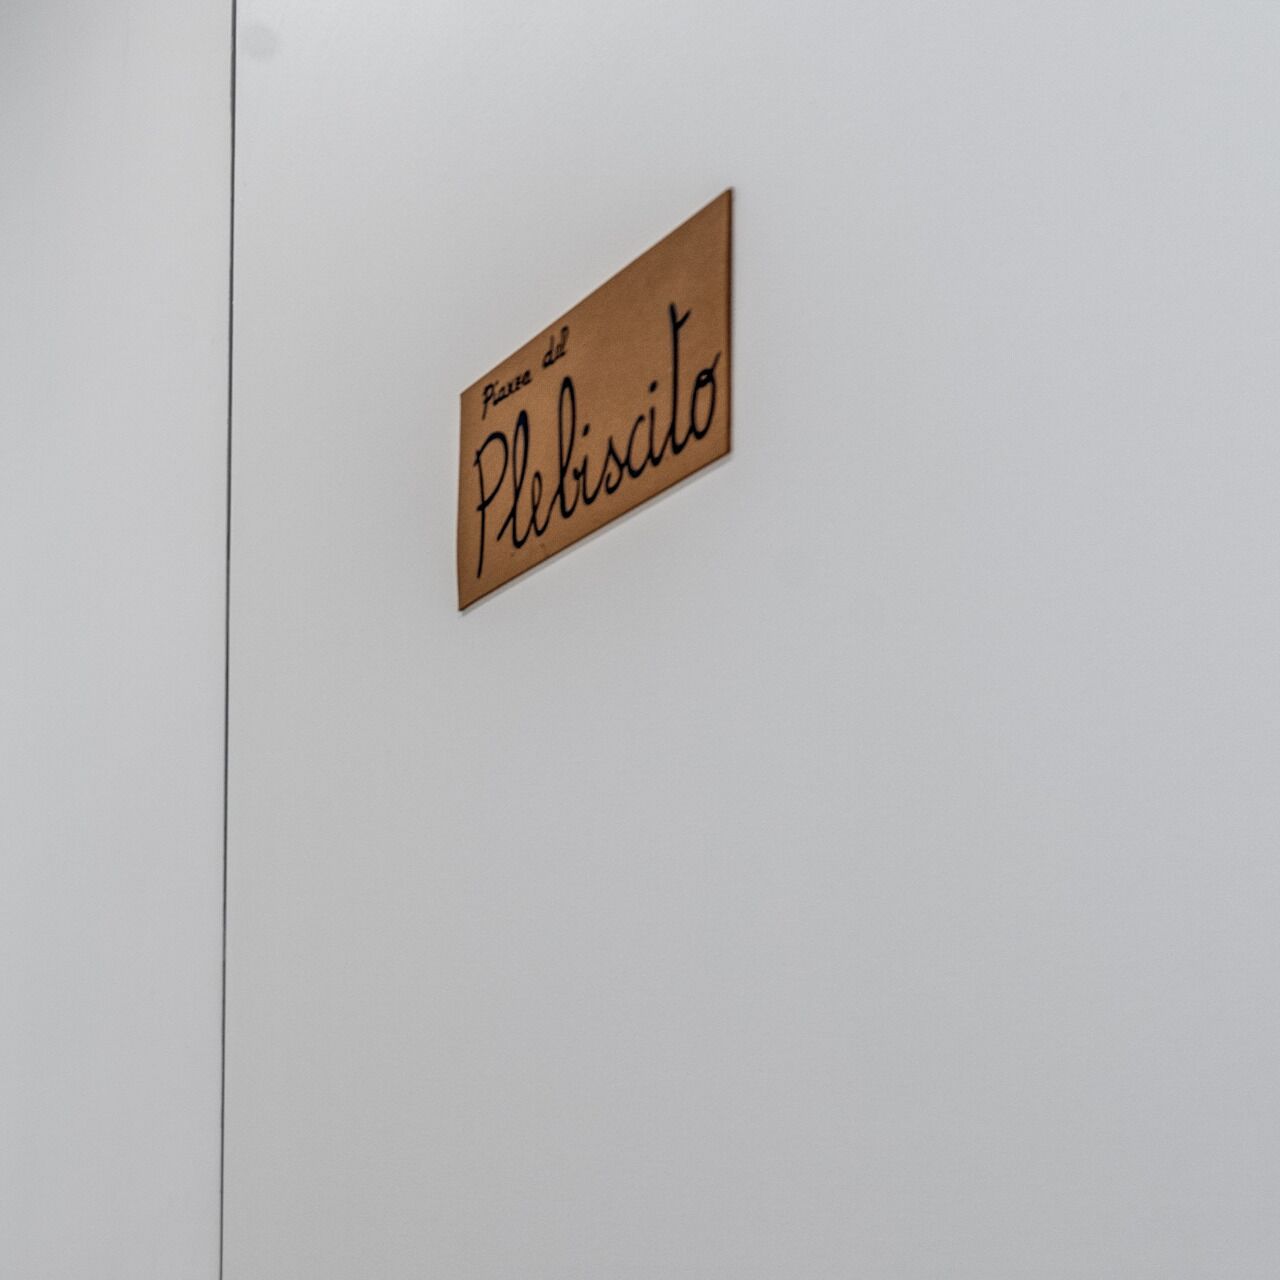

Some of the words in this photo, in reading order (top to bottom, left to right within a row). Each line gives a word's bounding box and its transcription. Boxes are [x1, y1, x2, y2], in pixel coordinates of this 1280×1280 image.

[473, 302, 722, 579] Plebiscito
[482, 369, 533, 420] Piazza
[542, 325, 569, 368] del
